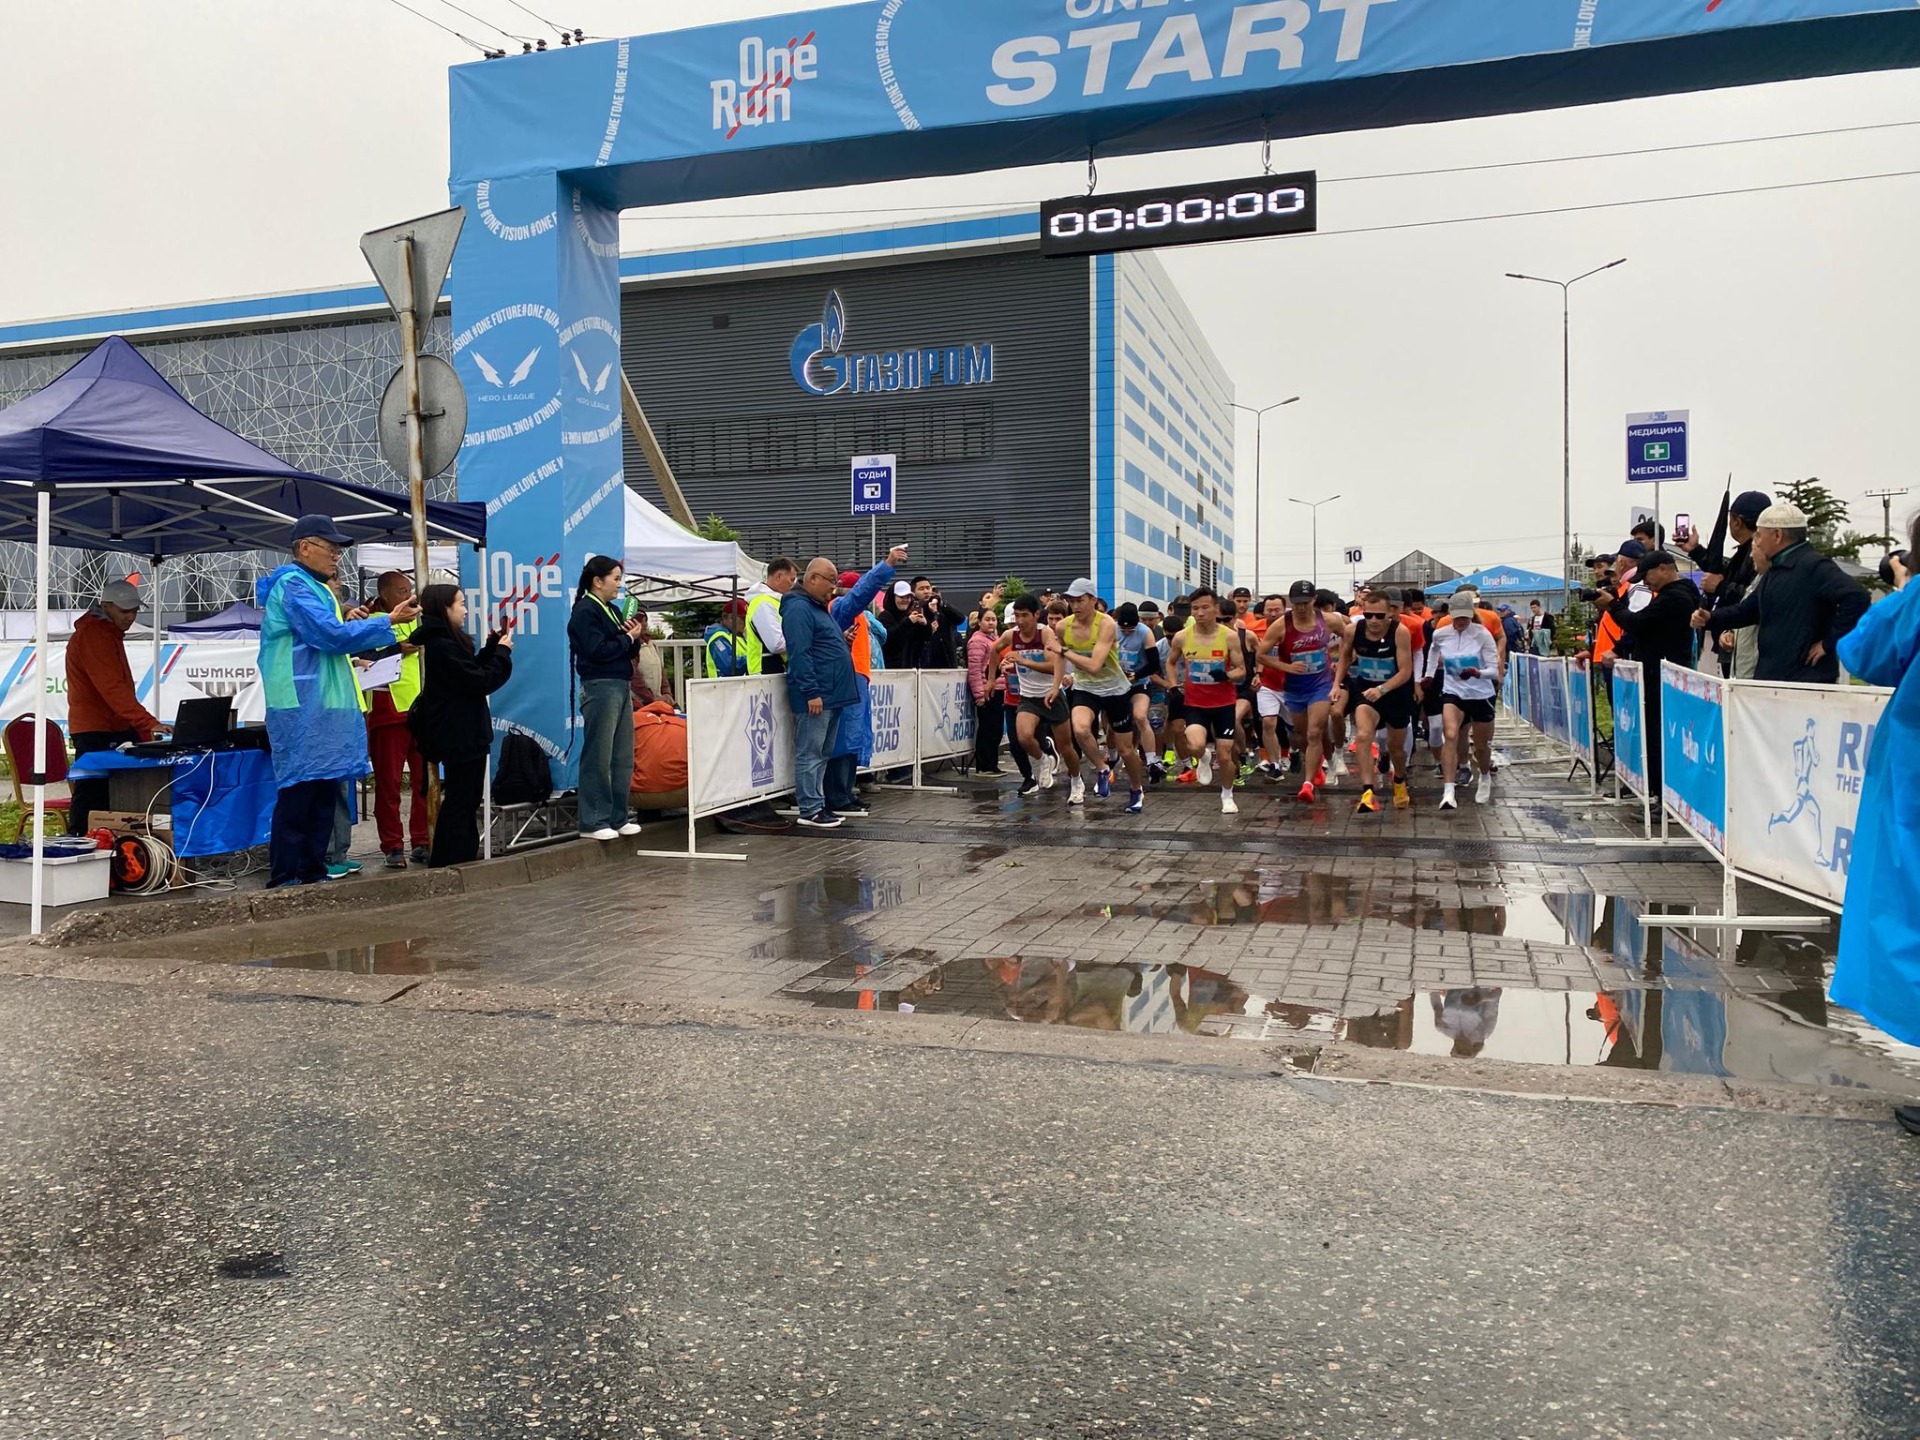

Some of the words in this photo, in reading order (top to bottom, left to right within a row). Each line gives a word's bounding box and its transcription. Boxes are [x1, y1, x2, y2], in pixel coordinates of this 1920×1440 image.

[739, 36, 818, 87] One
[985, 0, 1398, 106] START
[710, 79, 791, 131] Run
[1050, 187, 1305, 237] 00:00:00
[499, 224, 531, 241] VISION
[850, 343, 994, 394] ГАЗПРОМ
[478, 394, 500, 403] HERO
[503, 392, 536, 401] LEAGUE
[486, 425, 514, 443] VISION
[1629, 426, 1685, 437] МЕДИЦИНА
[858, 470, 887, 480] СУДЬИ
[1631, 464, 1684, 476] MEDICINE
[517, 471, 539, 493] LOVE
[854, 502, 891, 512] REFEREE
[1345, 549, 1362, 563] 10
[491, 551, 562, 598] One
[1500, 574, 1519, 585] Run
[186, 667, 256, 679] ШУМКАР
[870, 684, 894, 707] RUN
[876, 706, 901, 730] SILK
[953, 720, 976, 741] ROAD
[1836, 773, 1861, 794] THE
